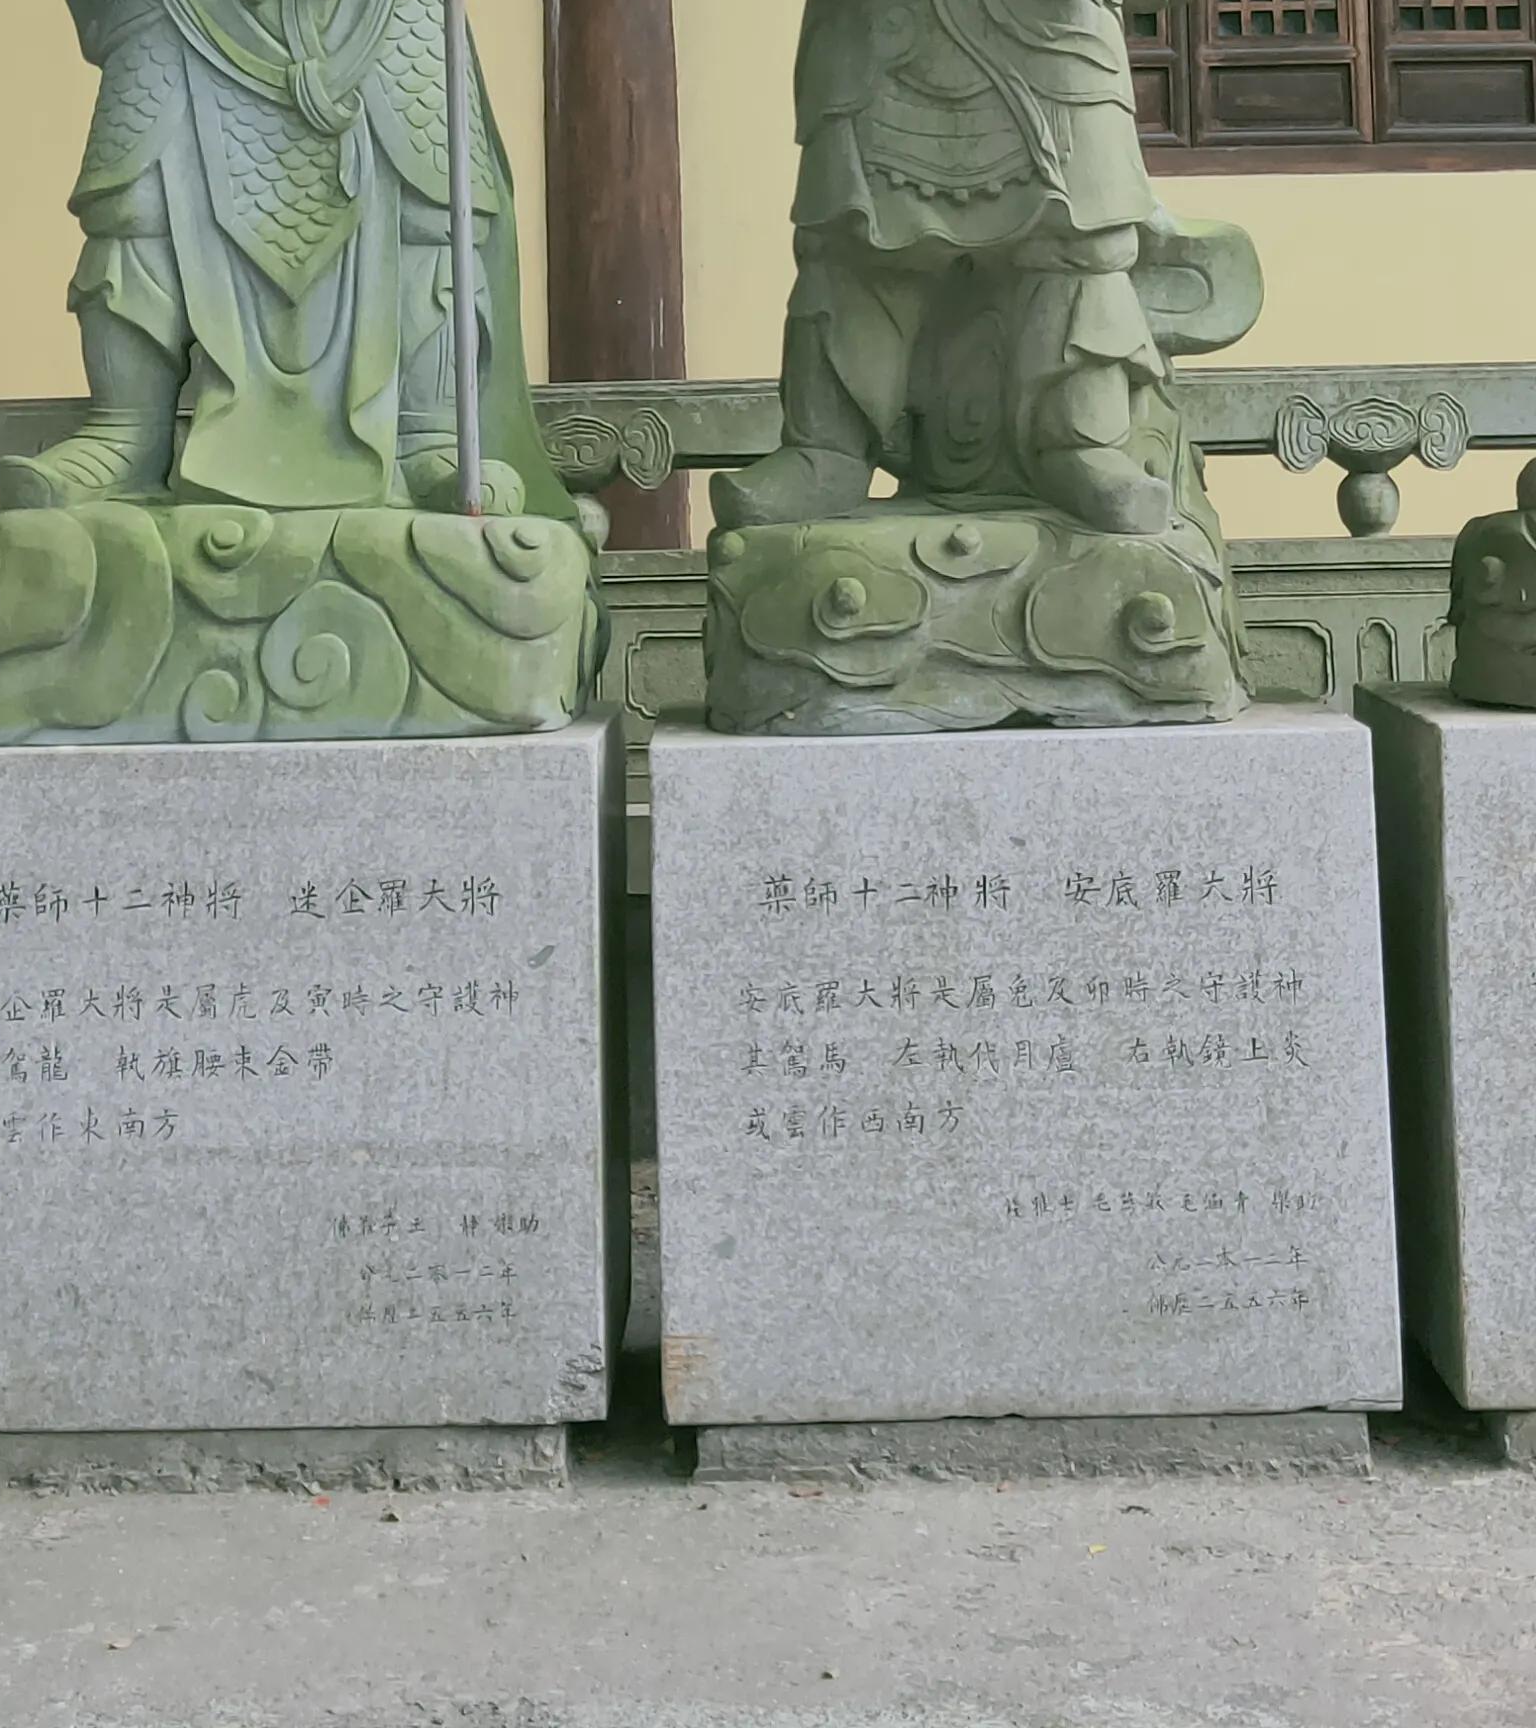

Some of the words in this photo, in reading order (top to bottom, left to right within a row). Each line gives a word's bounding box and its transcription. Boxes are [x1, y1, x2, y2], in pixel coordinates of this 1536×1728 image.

[290, 876, 504, 920] 迷企羅大將
[759, 874, 1011, 916] 藥師十二神將
[1064, 865, 1279, 909] 安底羅大將
[745, 1100, 965, 1141] 或雲作西南方
